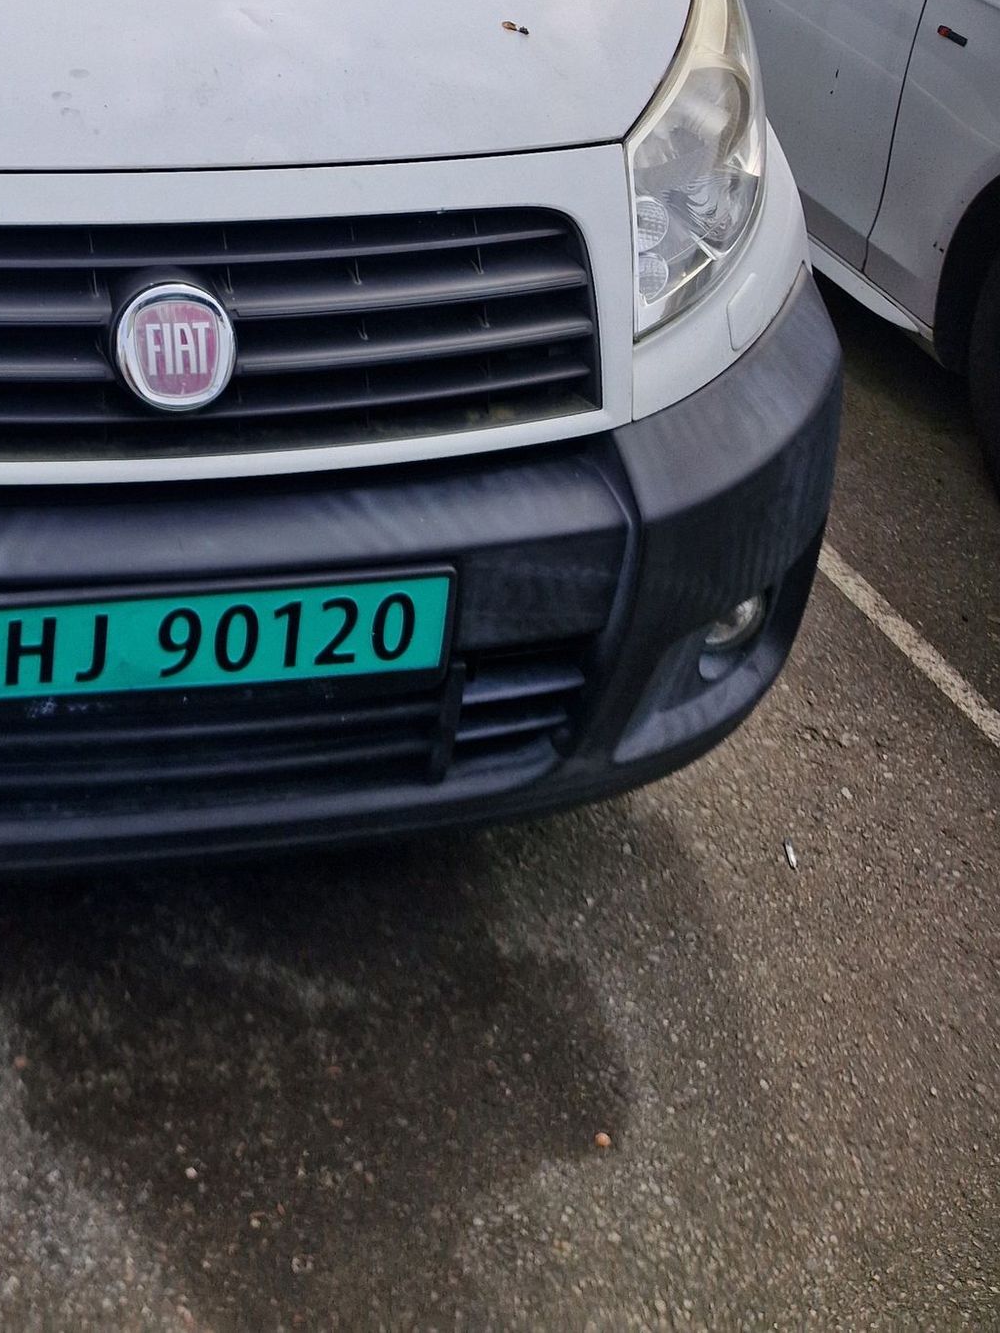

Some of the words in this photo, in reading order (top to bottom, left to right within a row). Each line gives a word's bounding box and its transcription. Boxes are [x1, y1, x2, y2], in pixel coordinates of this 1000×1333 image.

[145, 321, 210, 376] FIAT
[5, 614, 109, 686] HJ
[158, 592, 416, 678] 90120
